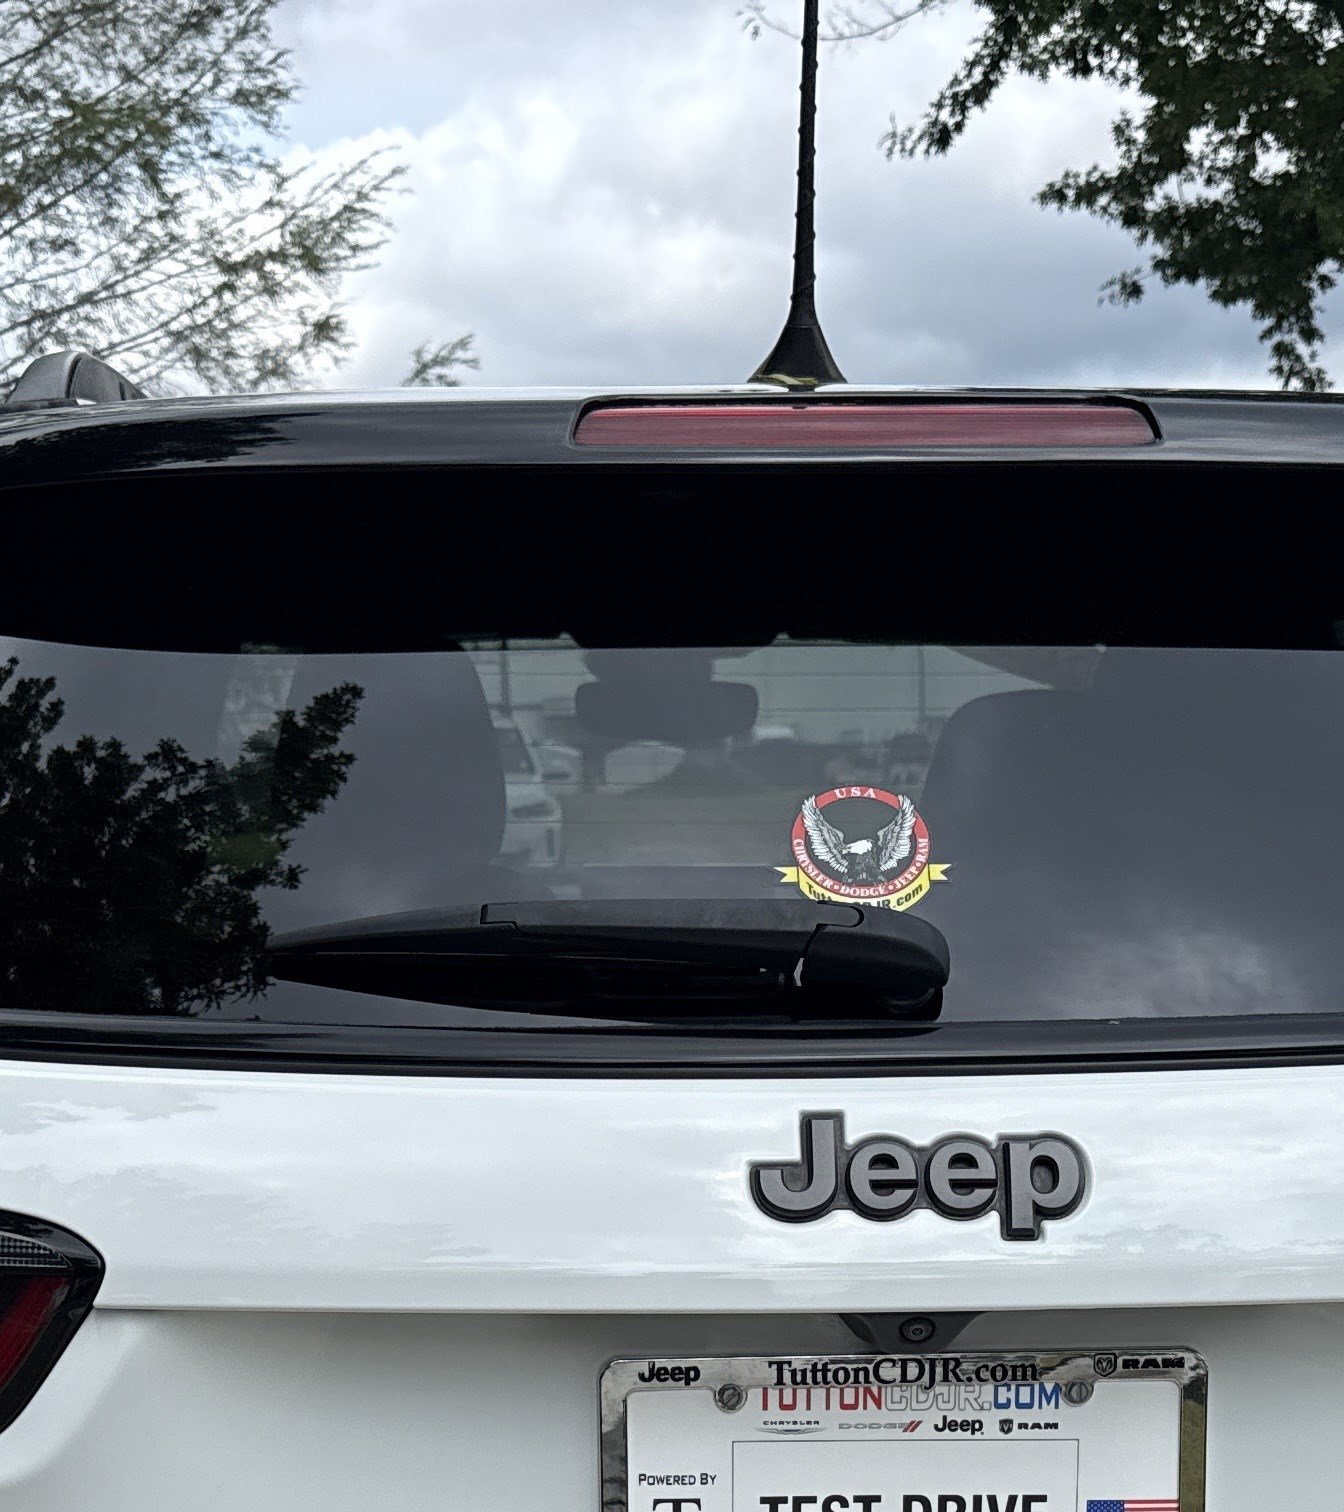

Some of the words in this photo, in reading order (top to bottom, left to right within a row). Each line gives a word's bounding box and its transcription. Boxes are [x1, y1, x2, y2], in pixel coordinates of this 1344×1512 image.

[834, 786, 876, 798] USA
[839, 884, 887, 898] DODGE
[893, 866, 921, 889] JEEP
[749, 1109, 1090, 1241] Jeep
[638, 1360, 701, 1386] Jeep
[1121, 1356, 1186, 1370] RAM
[768, 1357, 1040, 1391] TuttonCDJR.com
[838, 1422, 908, 1430] DODGE
[933, 1415, 985, 1435] Jeep
[1017, 1422, 1059, 1430] RAM
